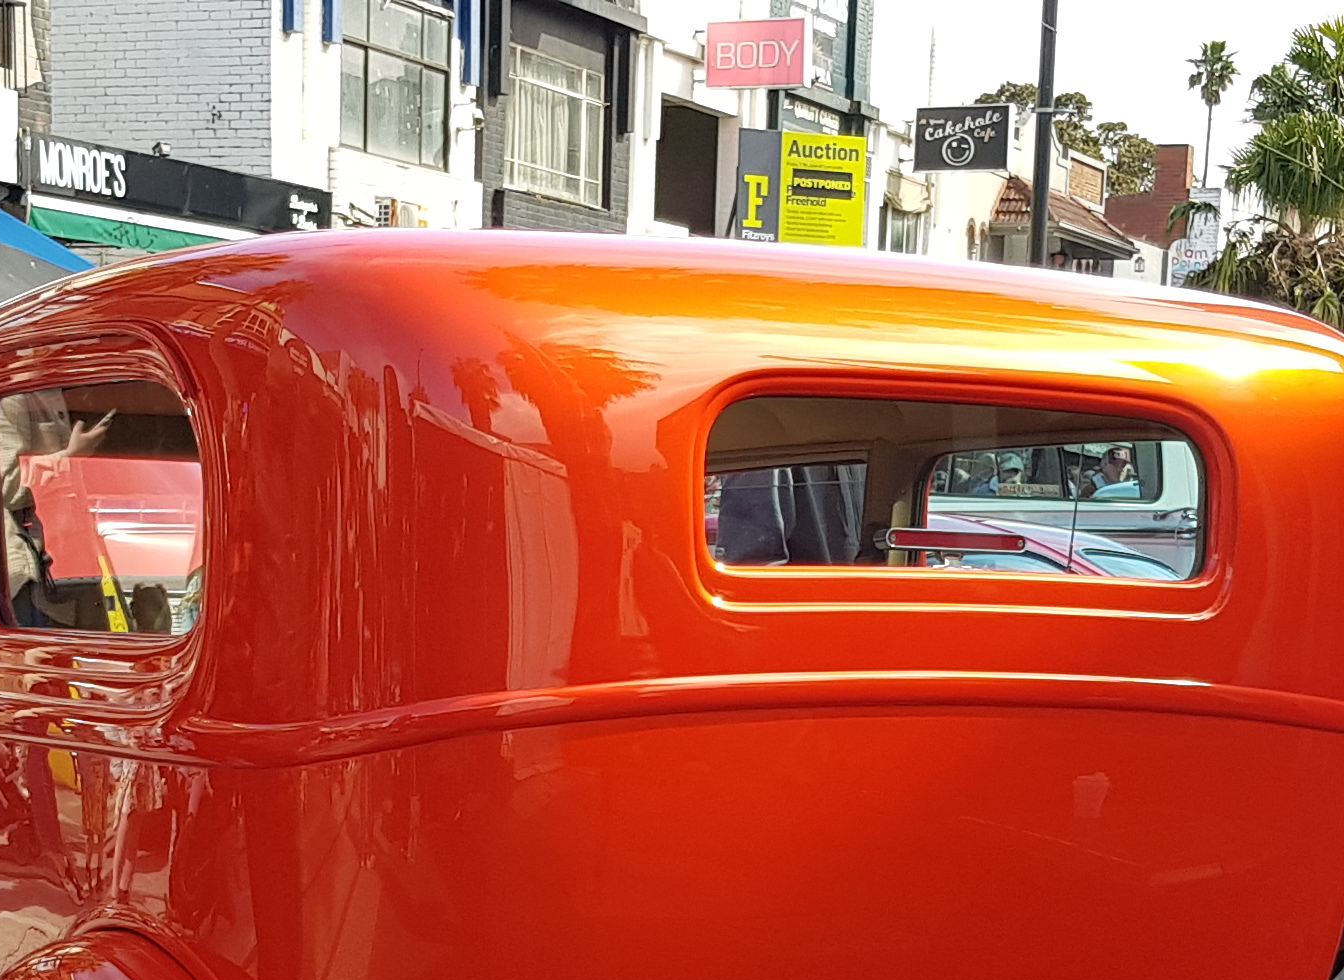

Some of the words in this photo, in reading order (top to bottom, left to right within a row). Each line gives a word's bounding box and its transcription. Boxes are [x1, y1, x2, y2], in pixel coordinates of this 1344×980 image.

[716, 39, 800, 69] BODY
[924, 110, 1002, 141] Cakehole
[788, 140, 860, 161] Auction
[39, 139, 126, 198] MONROE'S
[793, 178, 851, 190] POSTPONED
[786, 195, 826, 207] Freehold
[742, 229, 775, 241] Fitzroys
